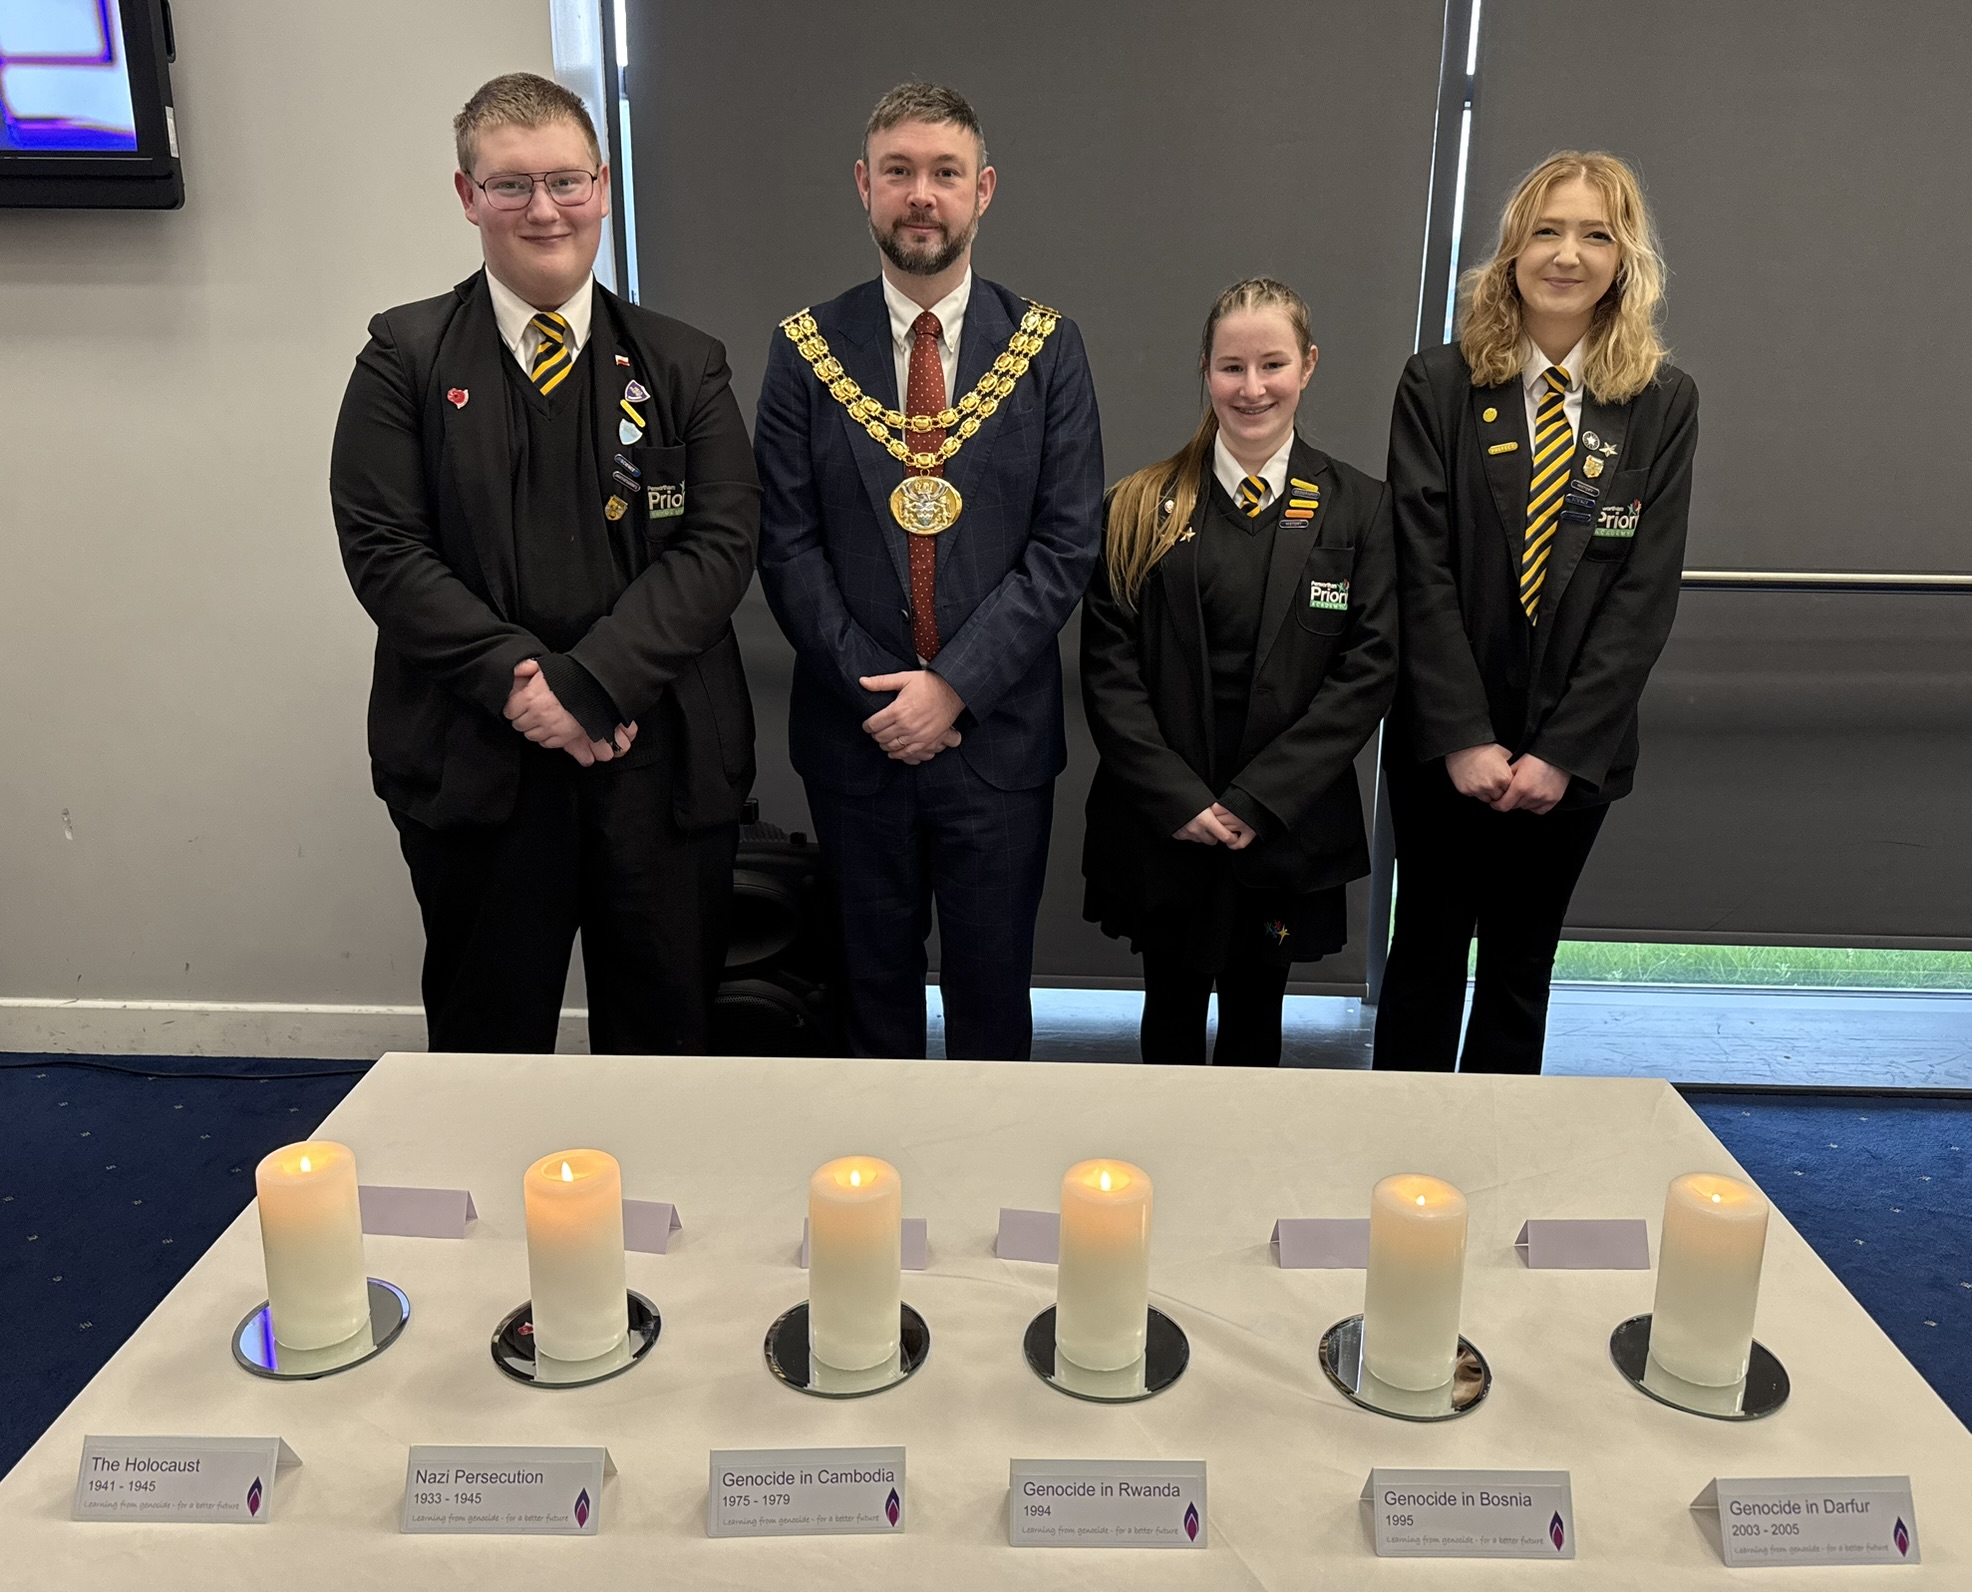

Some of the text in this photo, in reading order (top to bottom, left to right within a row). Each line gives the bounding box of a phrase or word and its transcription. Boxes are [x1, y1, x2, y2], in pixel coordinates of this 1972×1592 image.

[648, 490, 685, 510] Prio
[93, 1457, 200, 1472] The Holocaust
[416, 1470, 543, 1484] Nazi Persecution
[722, 1469, 894, 1487] Genocide in Cambodia
[88, 1480, 115, 1492] 1941
[128, 1481, 156, 1492] 1945
[1024, 1482, 1180, 1497] Genocide in Rwanda
[415, 1493, 442, 1503] 1933
[454, 1493, 481, 1503] 1945
[723, 1496, 750, 1507] 1975
[763, 1494, 790, 1505] 1979
[1385, 1491, 1532, 1506] Genocide in Bosnia
[1024, 1506, 1051, 1516] 1994
[1730, 1499, 1870, 1515] Genocide in Darfur
[413, 1515, 446, 1523] Learning
[449, 1514, 466, 1524] from
[468, 1514, 499, 1524] genocide
[506, 1514, 516, 1524] for
[546, 1514, 568, 1523] future
[723, 1517, 757, 1527] Learning
[759, 1516, 776, 1526] from
[779, 1516, 810, 1525] genocide
[817, 1514, 827, 1524] for
[856, 1513, 879, 1523] future
[1386, 1515, 1413, 1526] 1995
[1022, 1526, 1055, 1536] Learning
[1058, 1526, 1076, 1536] from
[1078, 1526, 1109, 1536] genocide
[1116, 1526, 1126, 1536] for
[1155, 1527, 1178, 1536] future
[1732, 1525, 1760, 1536] 2003
[1772, 1524, 1799, 1535] 2005
[1386, 1536, 1420, 1545] Learning
[1423, 1536, 1440, 1546] from
[1442, 1536, 1473, 1546] genocide
[1480, 1536, 1491, 1546] for
[1521, 1537, 1544, 1546] future
